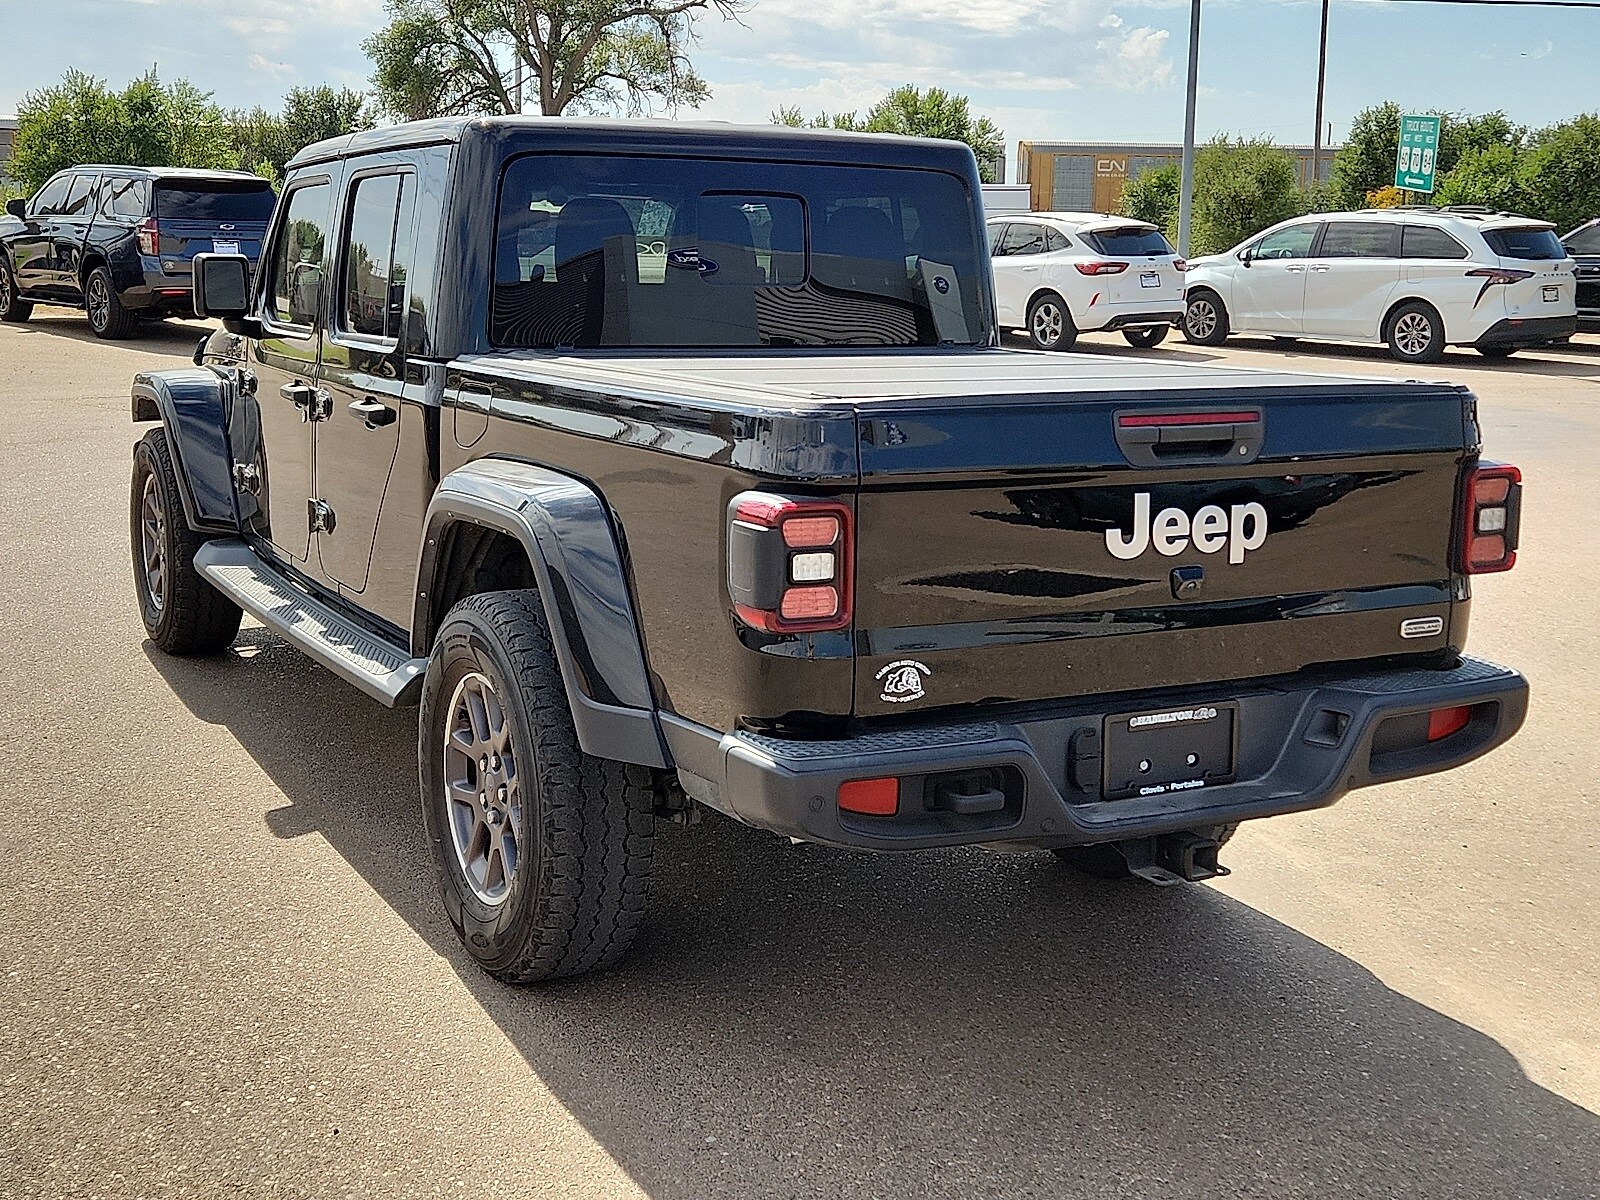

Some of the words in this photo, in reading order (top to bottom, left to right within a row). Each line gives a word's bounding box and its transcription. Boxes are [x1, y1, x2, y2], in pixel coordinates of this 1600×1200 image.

[1097, 159, 1126, 171] CN
[1412, 153, 1419, 167] 70
[1105, 492, 1268, 565] Jeep
[1140, 785, 1165, 796] Clovis
[1171, 779, 1205, 791] Portales
